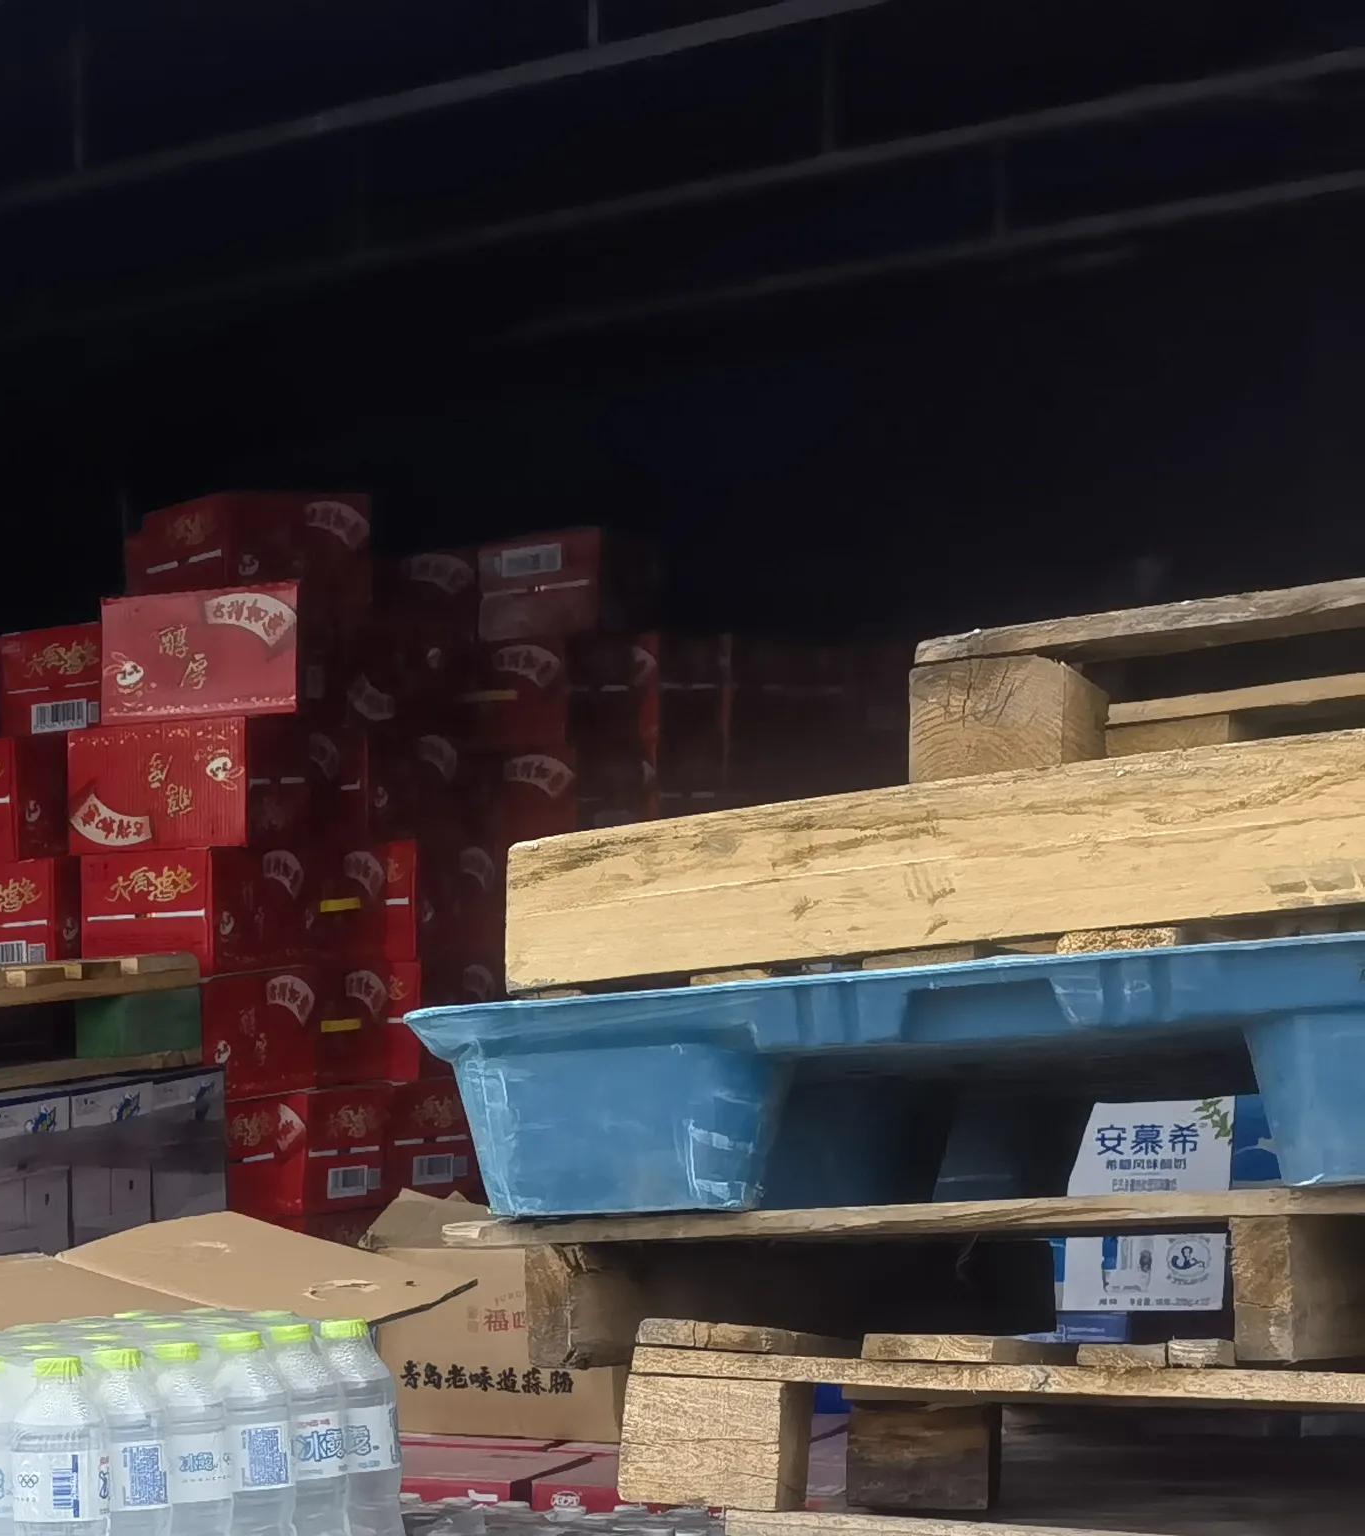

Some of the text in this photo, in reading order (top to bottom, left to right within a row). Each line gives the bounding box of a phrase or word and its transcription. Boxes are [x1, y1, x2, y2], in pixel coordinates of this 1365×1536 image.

[1095, 1122, 1200, 1156] 安慕希
[296, 1428, 344, 1461] 冰露
